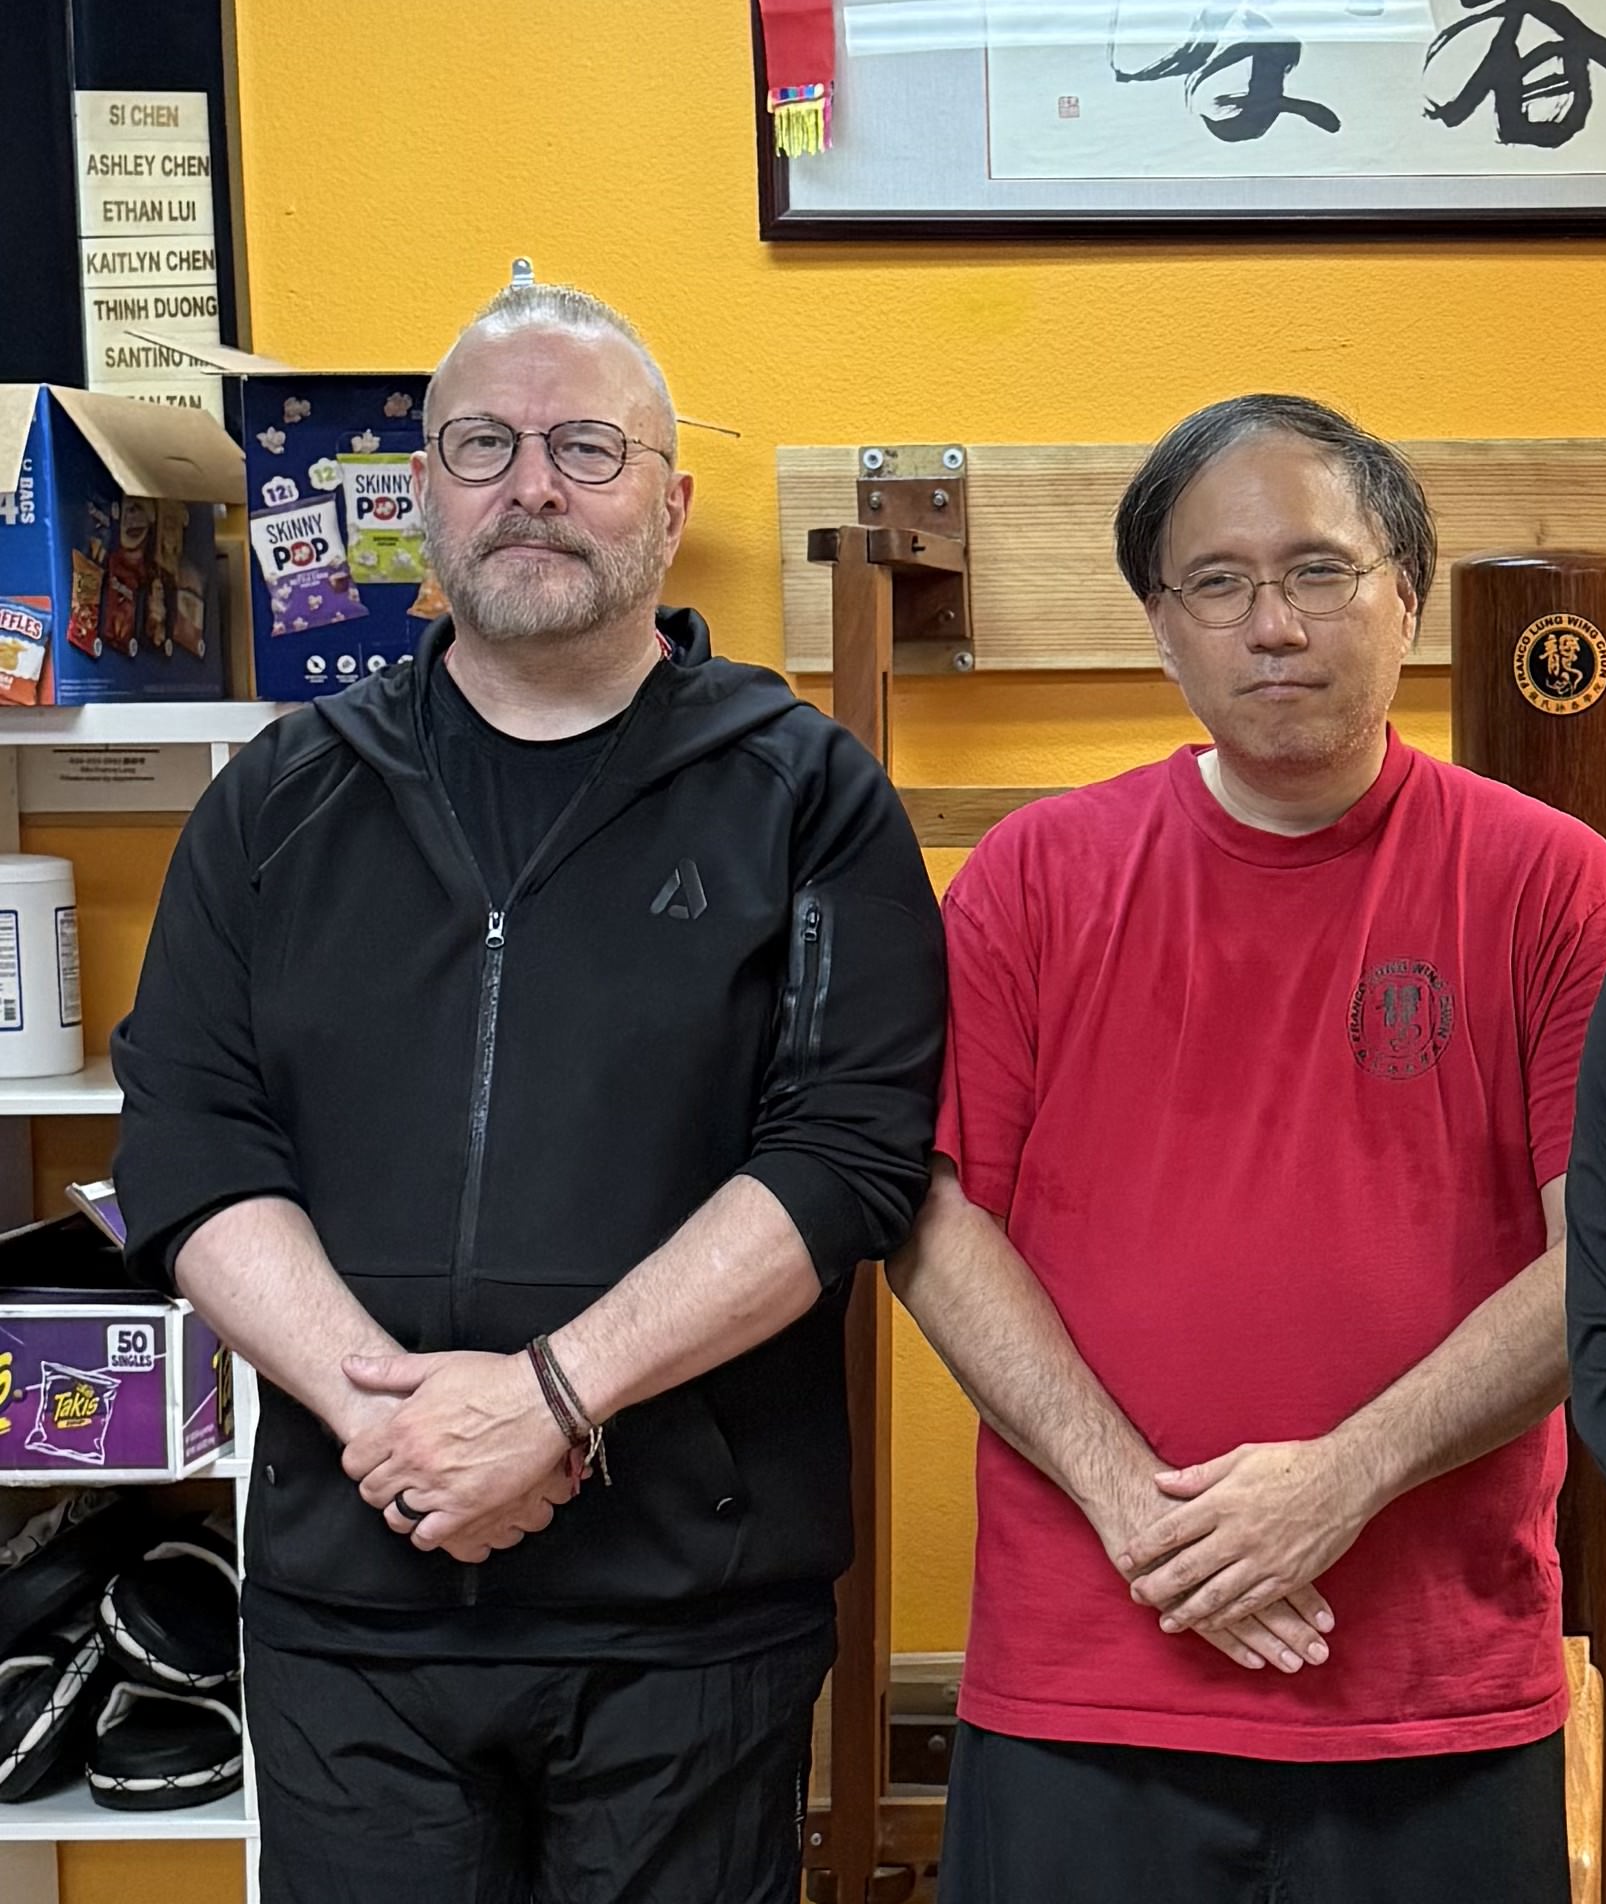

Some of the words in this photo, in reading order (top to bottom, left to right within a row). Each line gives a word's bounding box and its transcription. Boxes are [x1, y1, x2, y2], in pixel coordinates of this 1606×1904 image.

[109, 105, 125, 125] SI
[130, 105, 179, 127] CHEN
[87, 154, 155, 176] ASHLEY
[161, 155, 210, 176] CHEN
[103, 200, 162, 222] ETHAN
[168, 200, 196, 221] LUI
[87, 251, 160, 274] KAITLYN
[166, 249, 215, 271] CHEN
[93, 298, 149, 321] THINH
[154, 296, 217, 318] DUONG
[105, 346, 183, 368] SANTINO
[356, 474, 411, 494] SKINNY
[357, 496, 413, 521] POP
[266, 512, 323, 545] SKINNY
[273, 537, 329, 571] POP
[1515, 636, 1531, 690] FRANCO
[1529, 615, 1563, 637] LUNG
[1567, 616, 1598, 639] WING
[117, 1331, 148, 1353] 50
[111, 1354, 152, 1367] SINGLES
[54, 1392, 99, 1422] Takis
